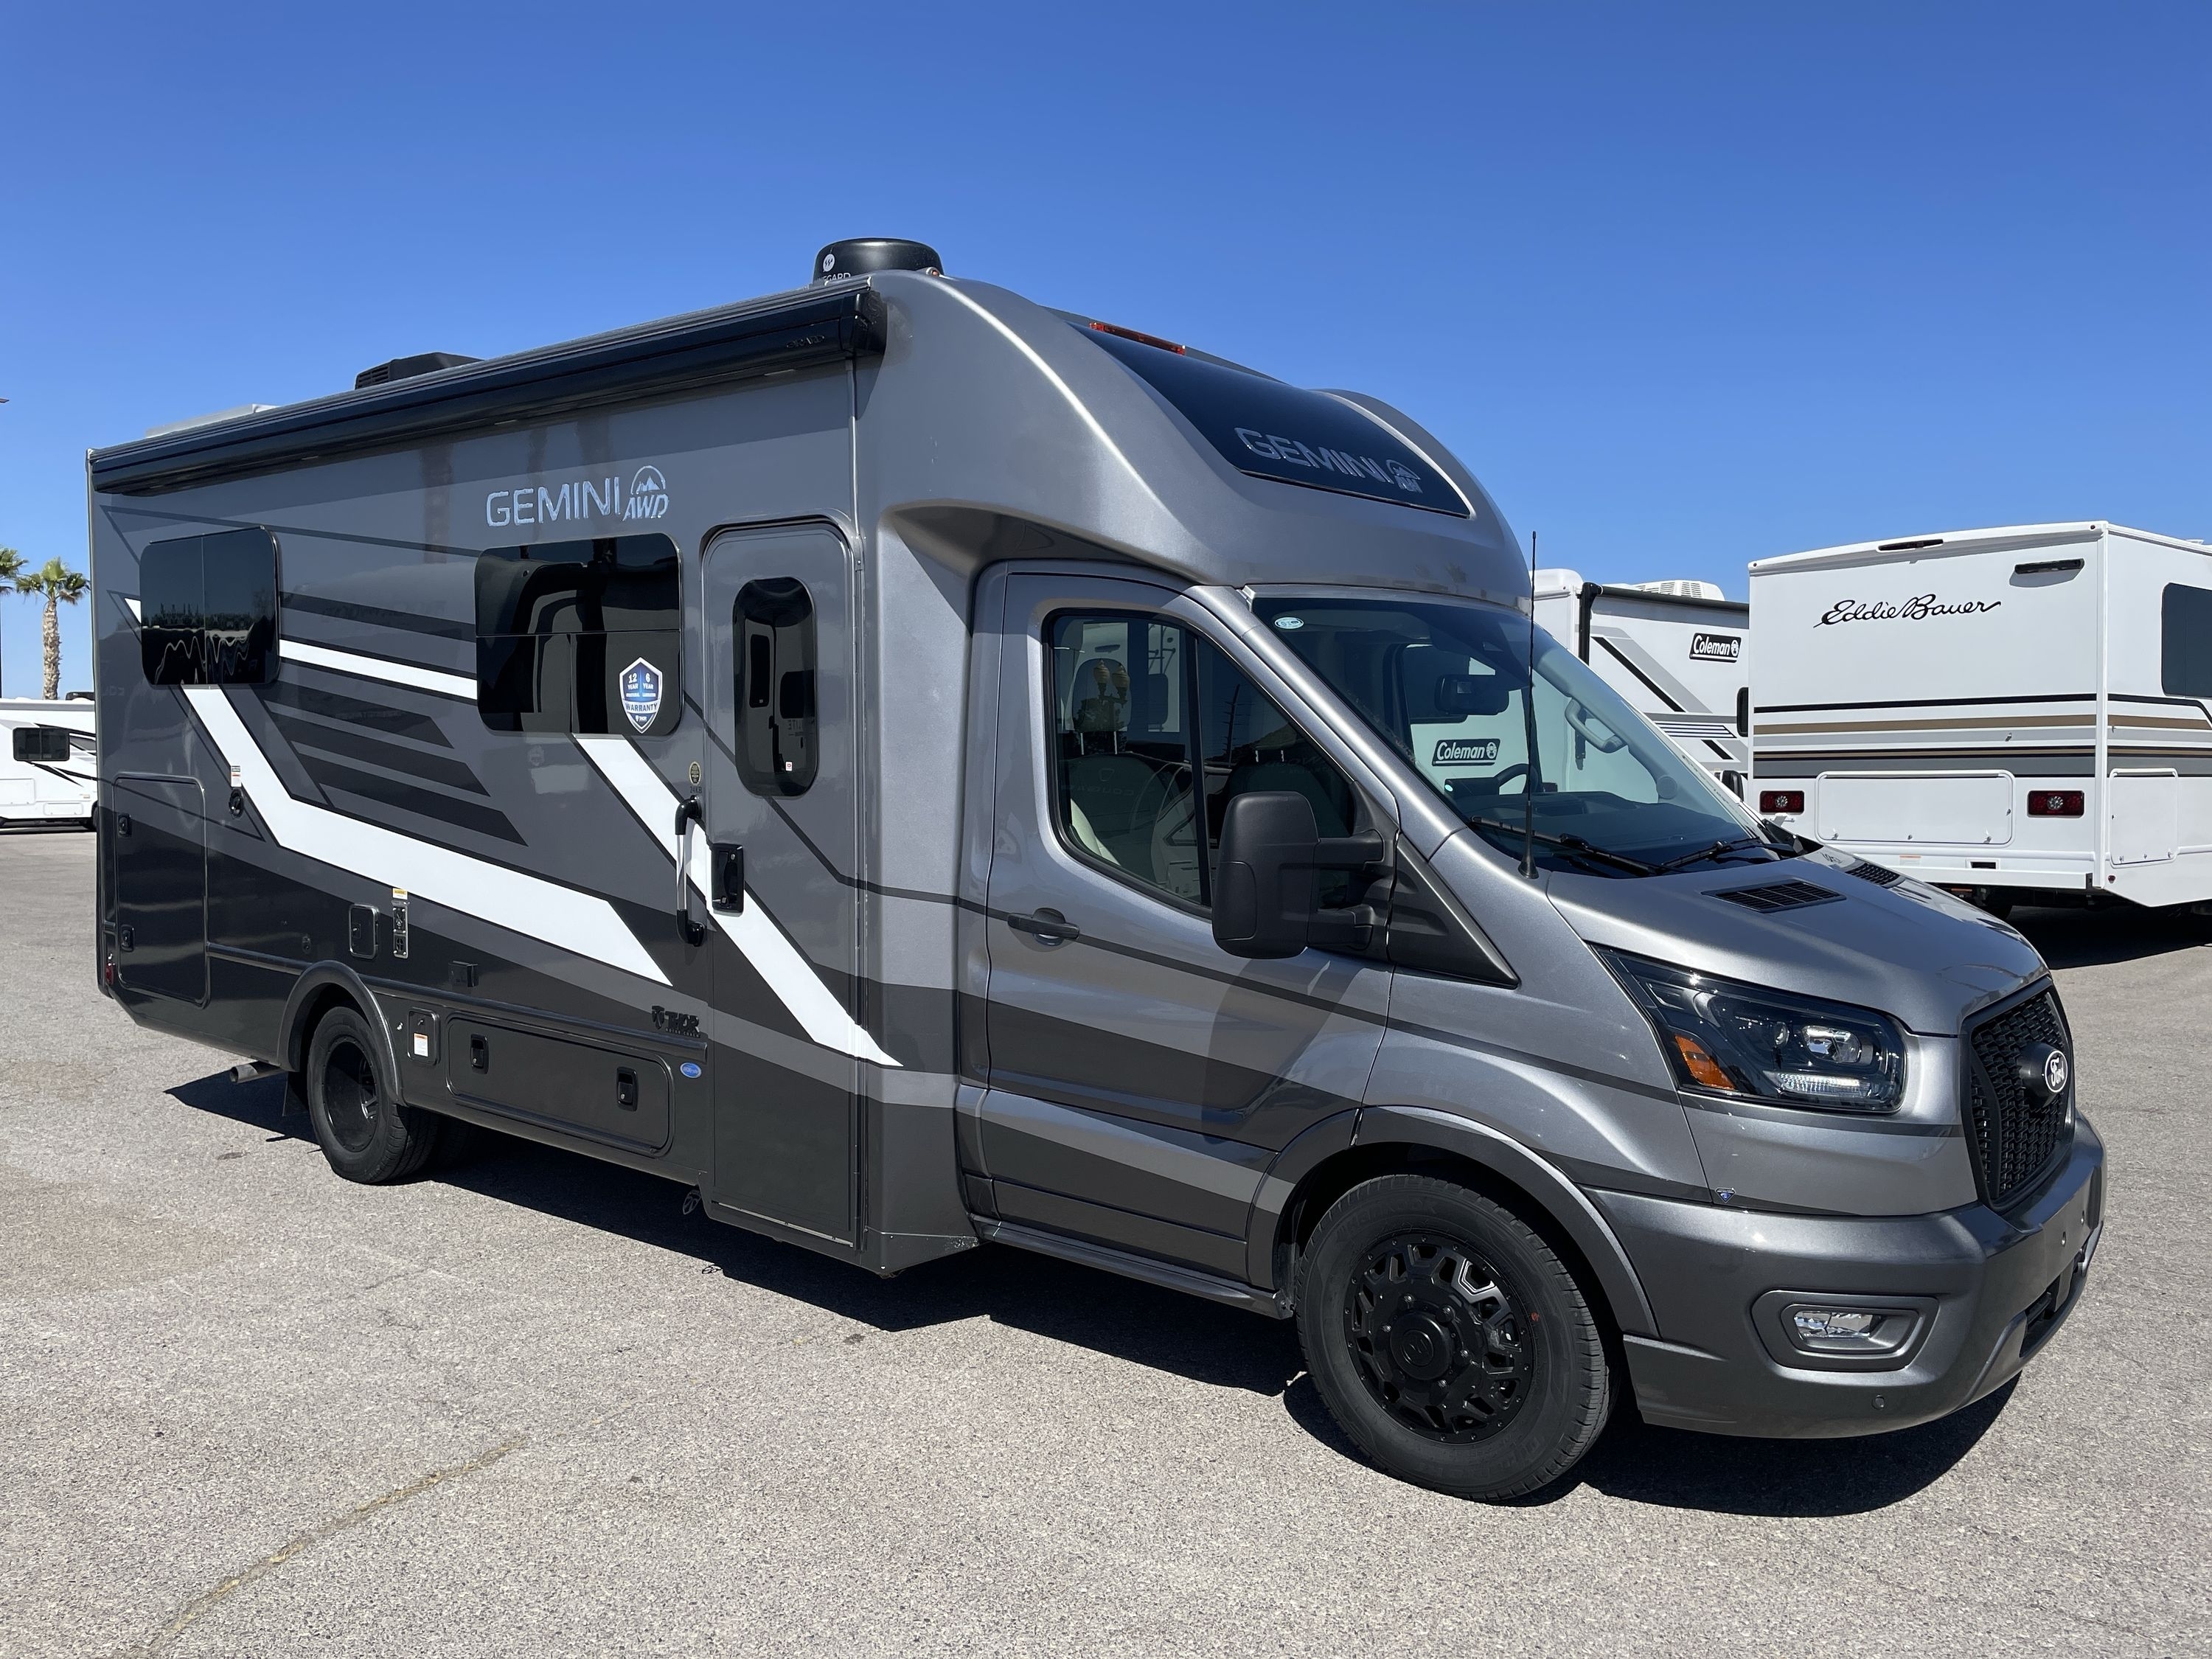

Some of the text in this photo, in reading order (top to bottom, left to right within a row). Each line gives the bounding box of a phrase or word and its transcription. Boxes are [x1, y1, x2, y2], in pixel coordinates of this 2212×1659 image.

[1234, 427, 1394, 484] GEMINI
[486, 476, 669, 526] GEMINI AWD
[1813, 593, 2002, 628] Eddie Bauer
[1693, 634, 1731, 656] Coleman
[627, 682, 654, 691] YEAR YEAR
[628, 672, 651, 684] 12 6
[625, 702, 658, 712] WARRANTY
[1436, 741, 1486, 761] Coleman
[2050, 1057, 2065, 1087] Ford
